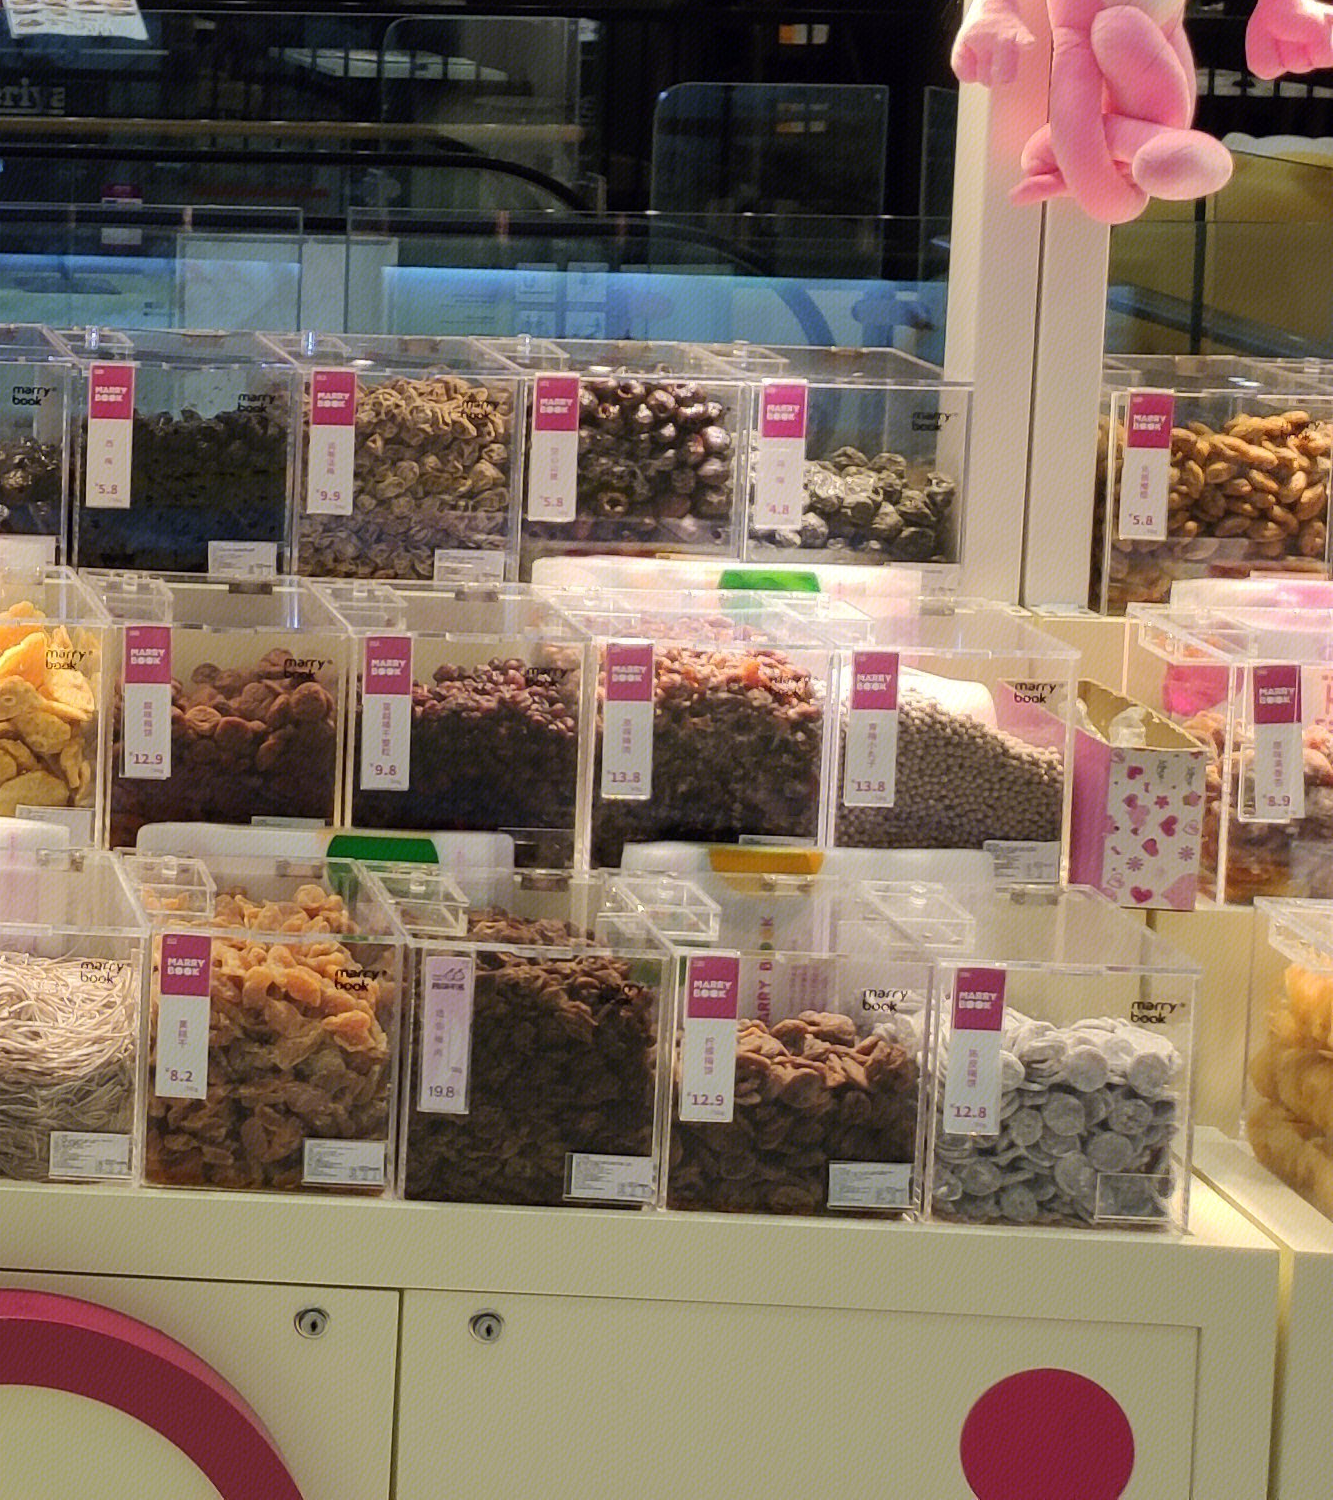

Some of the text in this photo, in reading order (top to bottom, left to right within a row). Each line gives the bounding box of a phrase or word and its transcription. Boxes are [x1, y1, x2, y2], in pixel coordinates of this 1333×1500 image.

[167, 957, 205, 968] MARRY
[167, 966, 200, 976] BOOK
[693, 980, 732, 991] MARRY
[693, 989, 727, 998] BOOK
[959, 991, 997, 1001] MARRY
[959, 999, 992, 1010] BOOK
